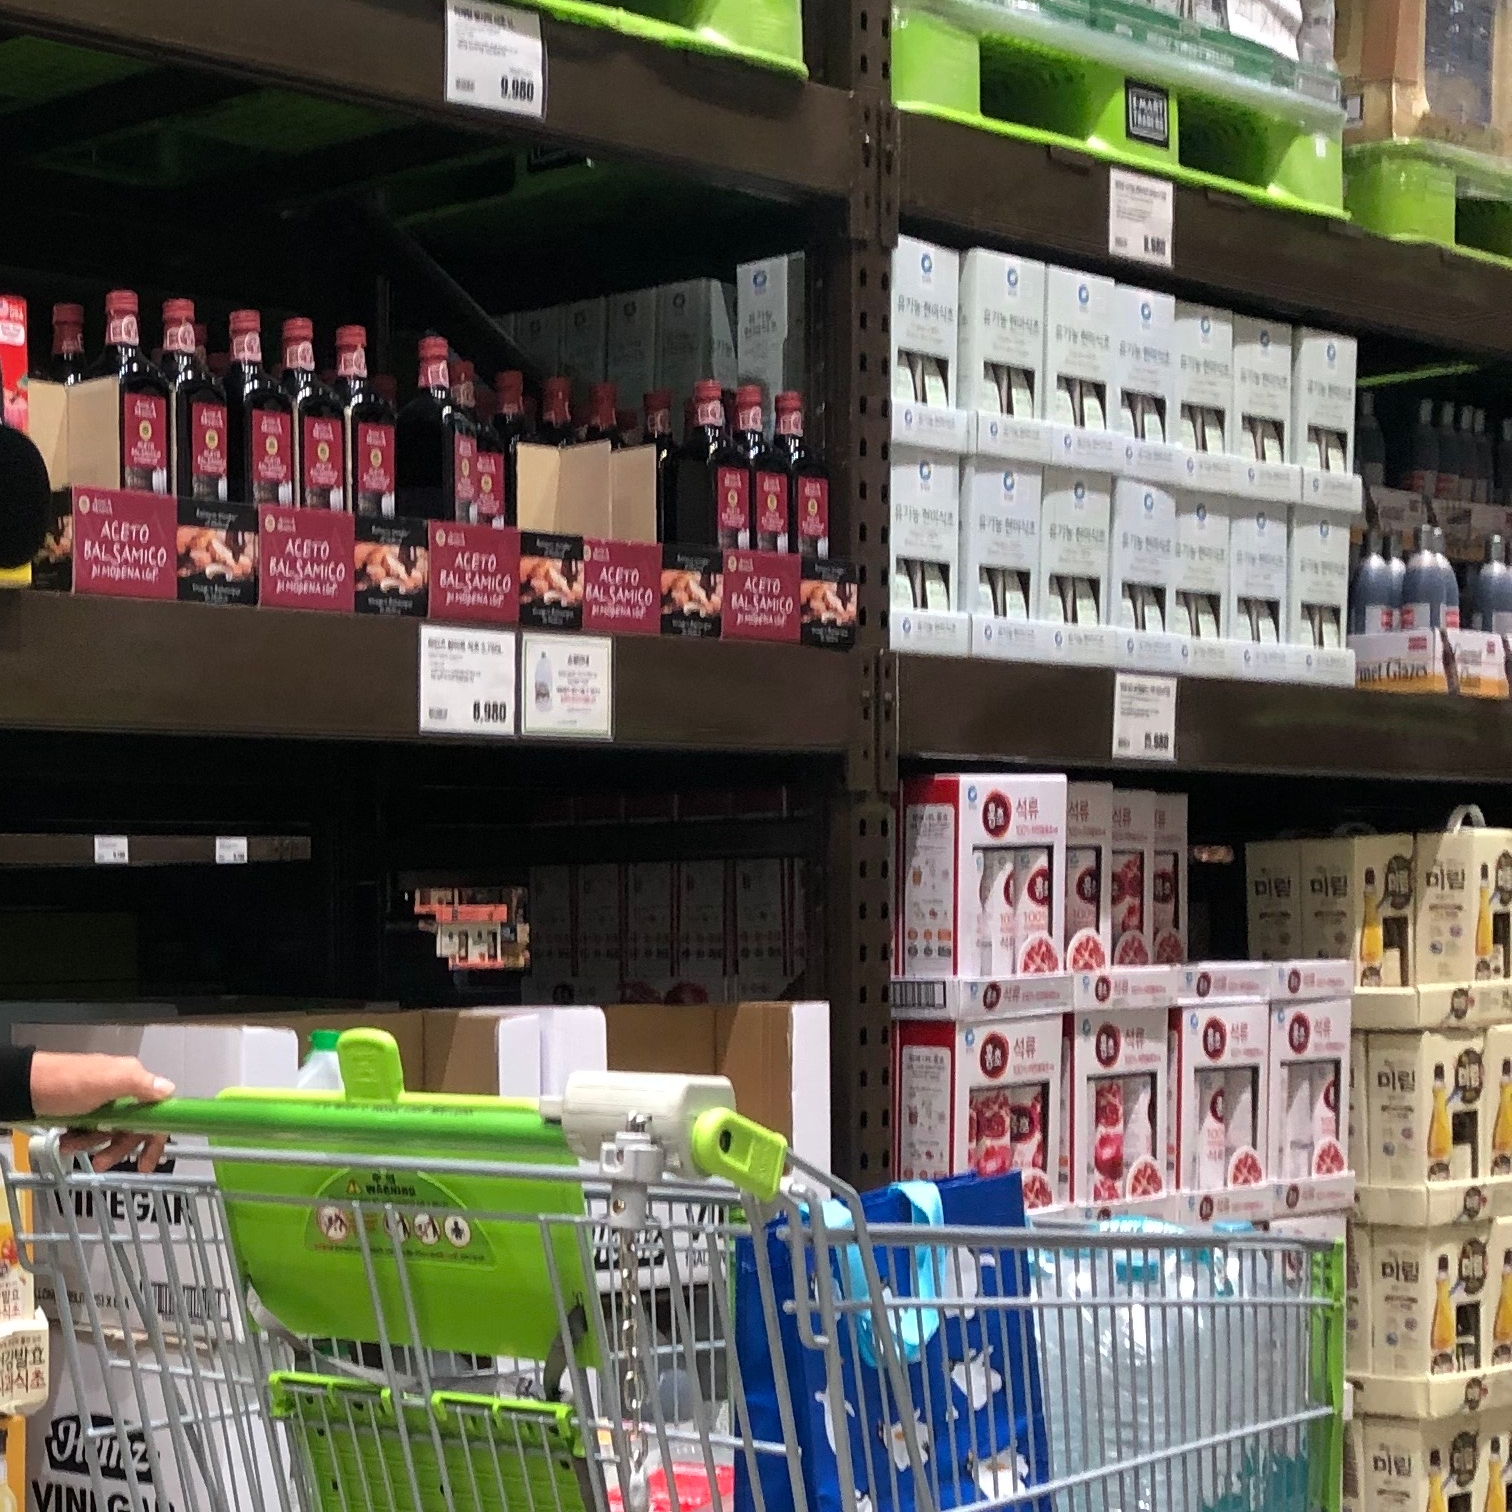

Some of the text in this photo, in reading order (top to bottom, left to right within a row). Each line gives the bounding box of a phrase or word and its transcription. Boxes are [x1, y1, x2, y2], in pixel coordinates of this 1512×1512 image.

[895, 503, 920, 524] 유기농
[100, 520, 149, 544] ACETO
[84, 540, 167, 567] BALSAMICO
[285, 538, 329, 561] ACETO
[269, 556, 345, 583] BALSAMICO
[454, 551, 497, 573] ACETO
[439, 568, 511, 593] BALSAMICO
[599, 565, 639, 588] ACETO
[744, 576, 780, 594] ACETO
[586, 581, 653, 607] BALSAMICO
[731, 590, 794, 614] BALSAMICO
[1016, 796, 1040, 820] 석류
[1068, 798, 1090, 823] 석류
[1310, 876, 1348, 897] 미림
[1426, 868, 1465, 890] 미림
[1125, 1027, 1146, 1049] 석류
[1231, 1022, 1249, 1042] 석류
[1314, 1017, 1333, 1038] 석류
[1013, 1035, 1036, 1060] 석류
[1377, 1069, 1415, 1091] 미림
[1381, 1261, 1419, 1283] 미림
[1373, 1453, 1411, 1477] 미림
